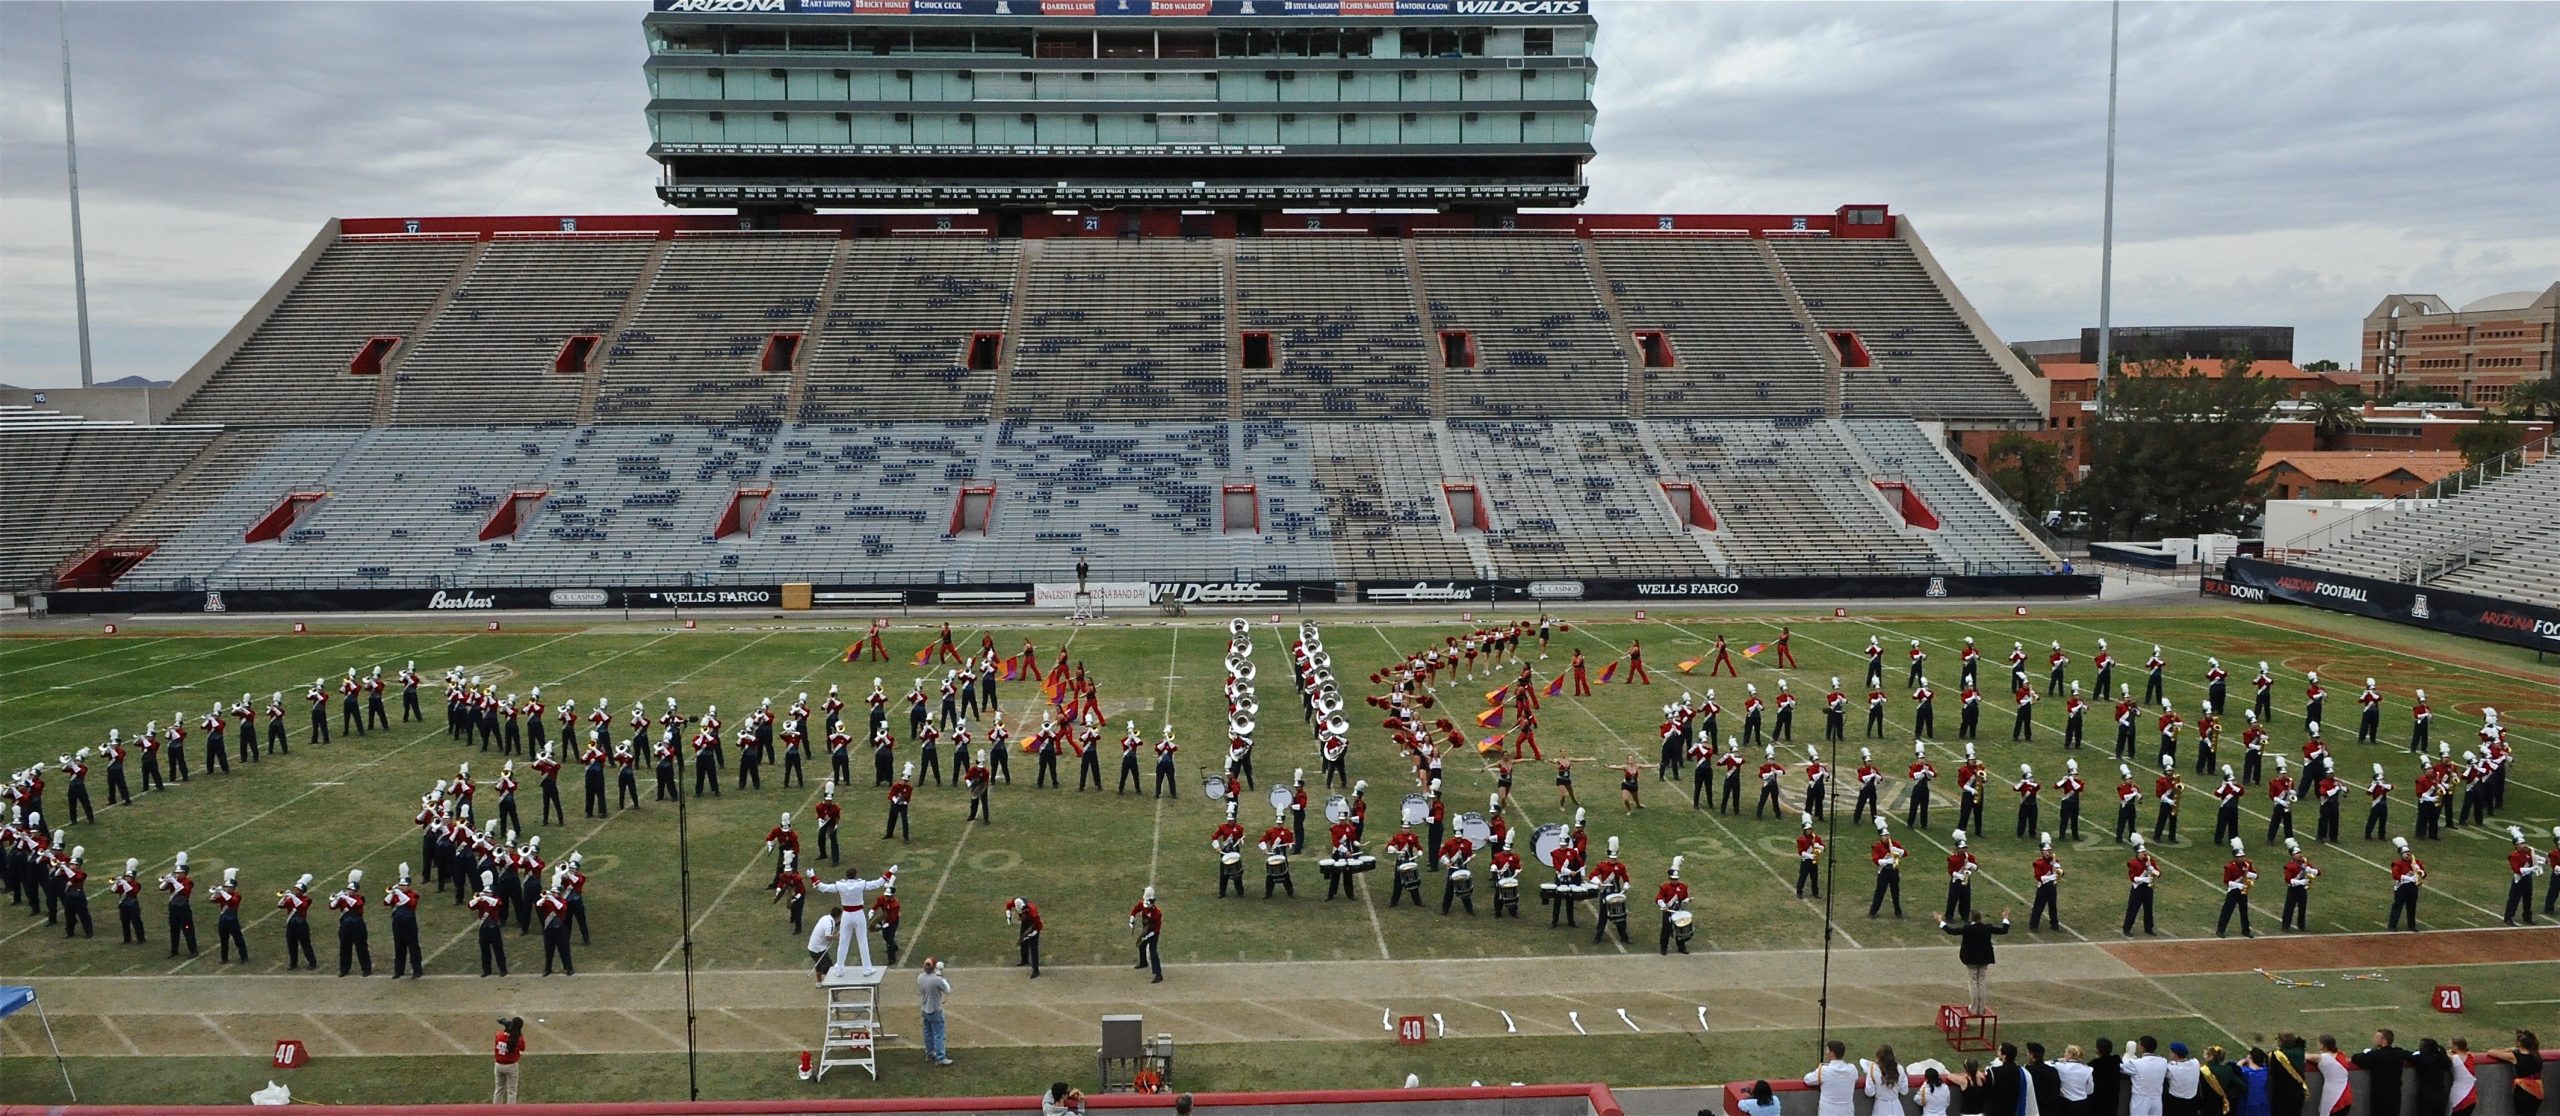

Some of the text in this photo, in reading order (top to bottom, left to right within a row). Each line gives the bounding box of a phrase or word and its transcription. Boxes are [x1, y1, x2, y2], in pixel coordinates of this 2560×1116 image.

[666, 0, 785, 11] ARIZONA
[920, 1, 943, 9] CHUCK
[1076, 2, 1095, 10] LEWIS
[1400, 2, 1426, 10] ANTOINE
[1456, 0, 1581, 14] WILDCATS
[407, 225, 418, 233] 17
[562, 222, 575, 232] 18
[740, 222, 751, 230] 19
[937, 221, 951, 230] 20
[1086, 220, 1098, 230] 21
[1307, 221, 1320, 230] 22
[1502, 220, 1515, 229] 23
[1659, 221, 1673, 230] 24
[1792, 221, 1806, 230] 25
[35, 394, 46, 402] 16
[1637, 583, 1739, 594] WELLS FARGO
[1926, 578, 1947, 597] A
[2230, 584, 2264, 600] DOWN
[2314, 582, 2368, 602] FOOTBALL
[428, 590, 496, 609] Bashas'
[662, 592, 769, 603] WELLS FARGO
[1037, 590, 1072, 600] UNIVERSITY
[1113, 590, 1131, 599] BAND
[1133, 589, 1146, 598] DAY
[204, 592, 225, 611] A
[2411, 594, 2430, 619] A
[2480, 611, 2535, 631] ARIZONA
[2441, 990, 2461, 1009] 20
[1403, 1020, 1421, 1040] 40
[275, 1044, 295, 1064] 40
